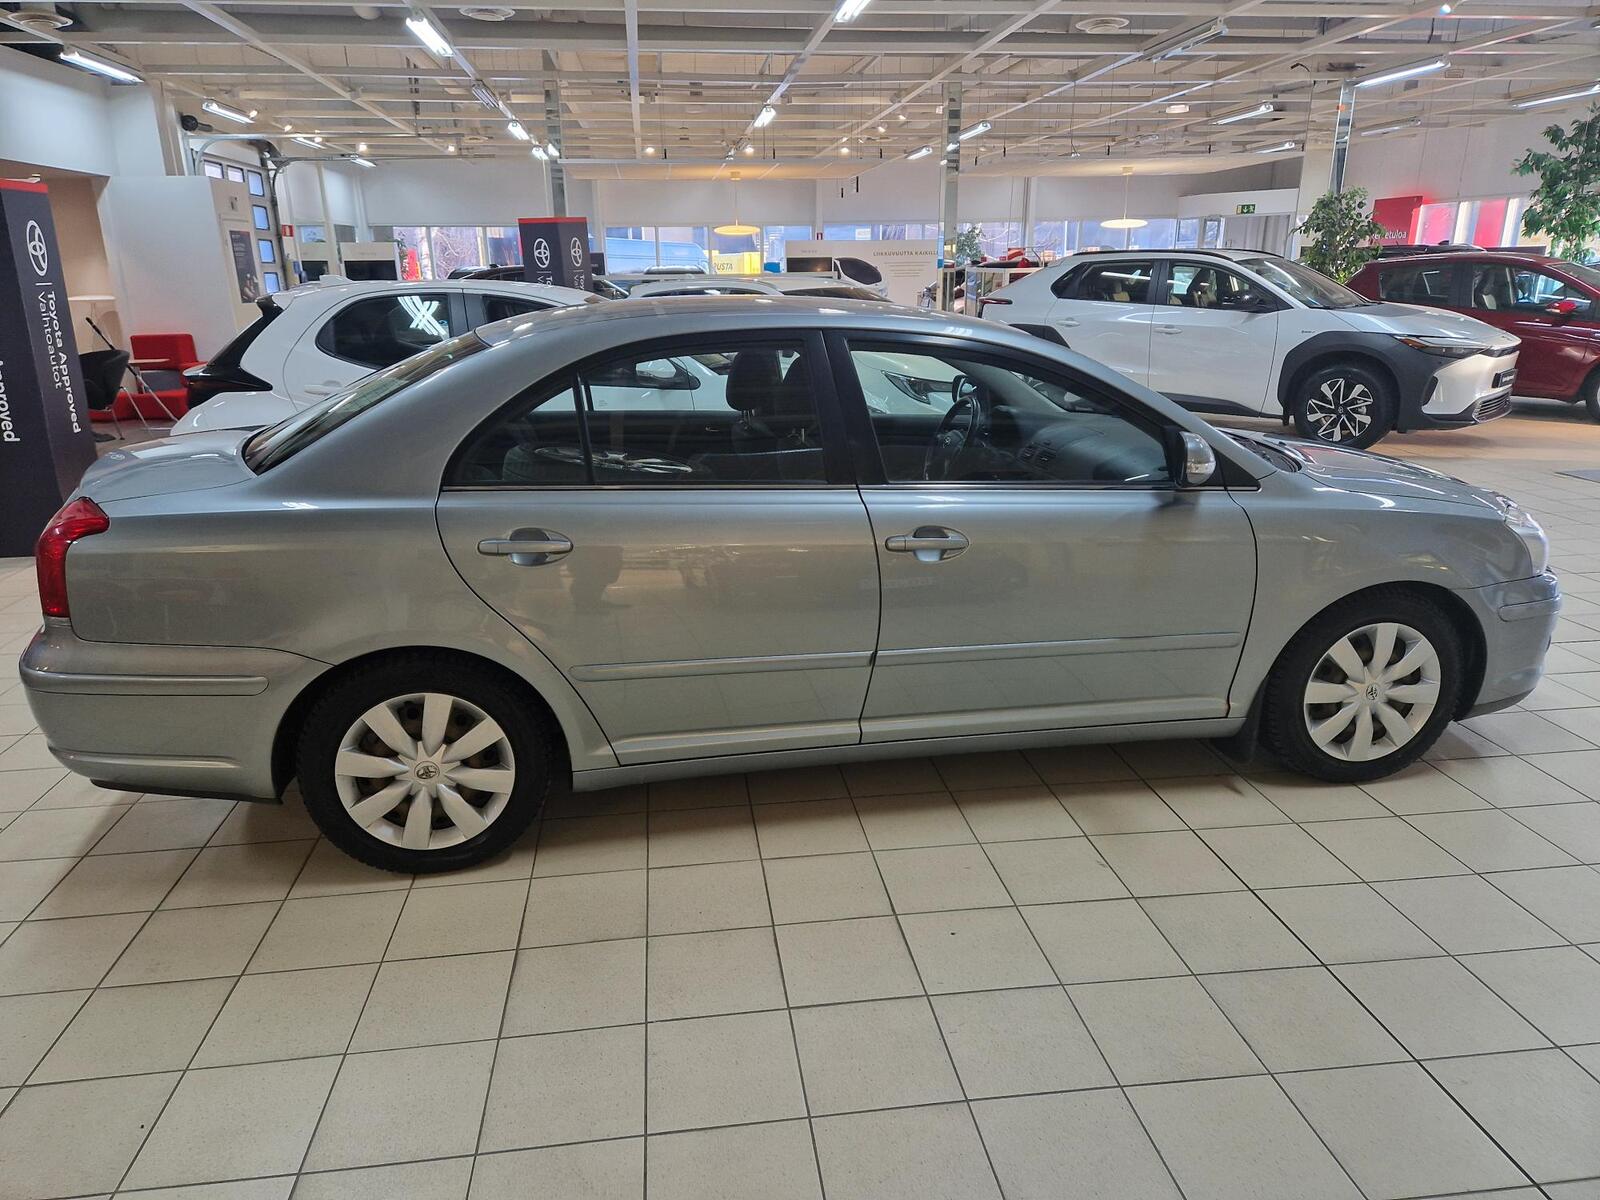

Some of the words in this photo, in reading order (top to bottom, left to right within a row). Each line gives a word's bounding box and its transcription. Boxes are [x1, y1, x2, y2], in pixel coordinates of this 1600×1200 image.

[38, 291, 62, 389] Vaihtoautot
[47, 291, 63, 348] Toyota
[58, 352, 82, 434] Approved
[0, 360, 20, 442] proved
